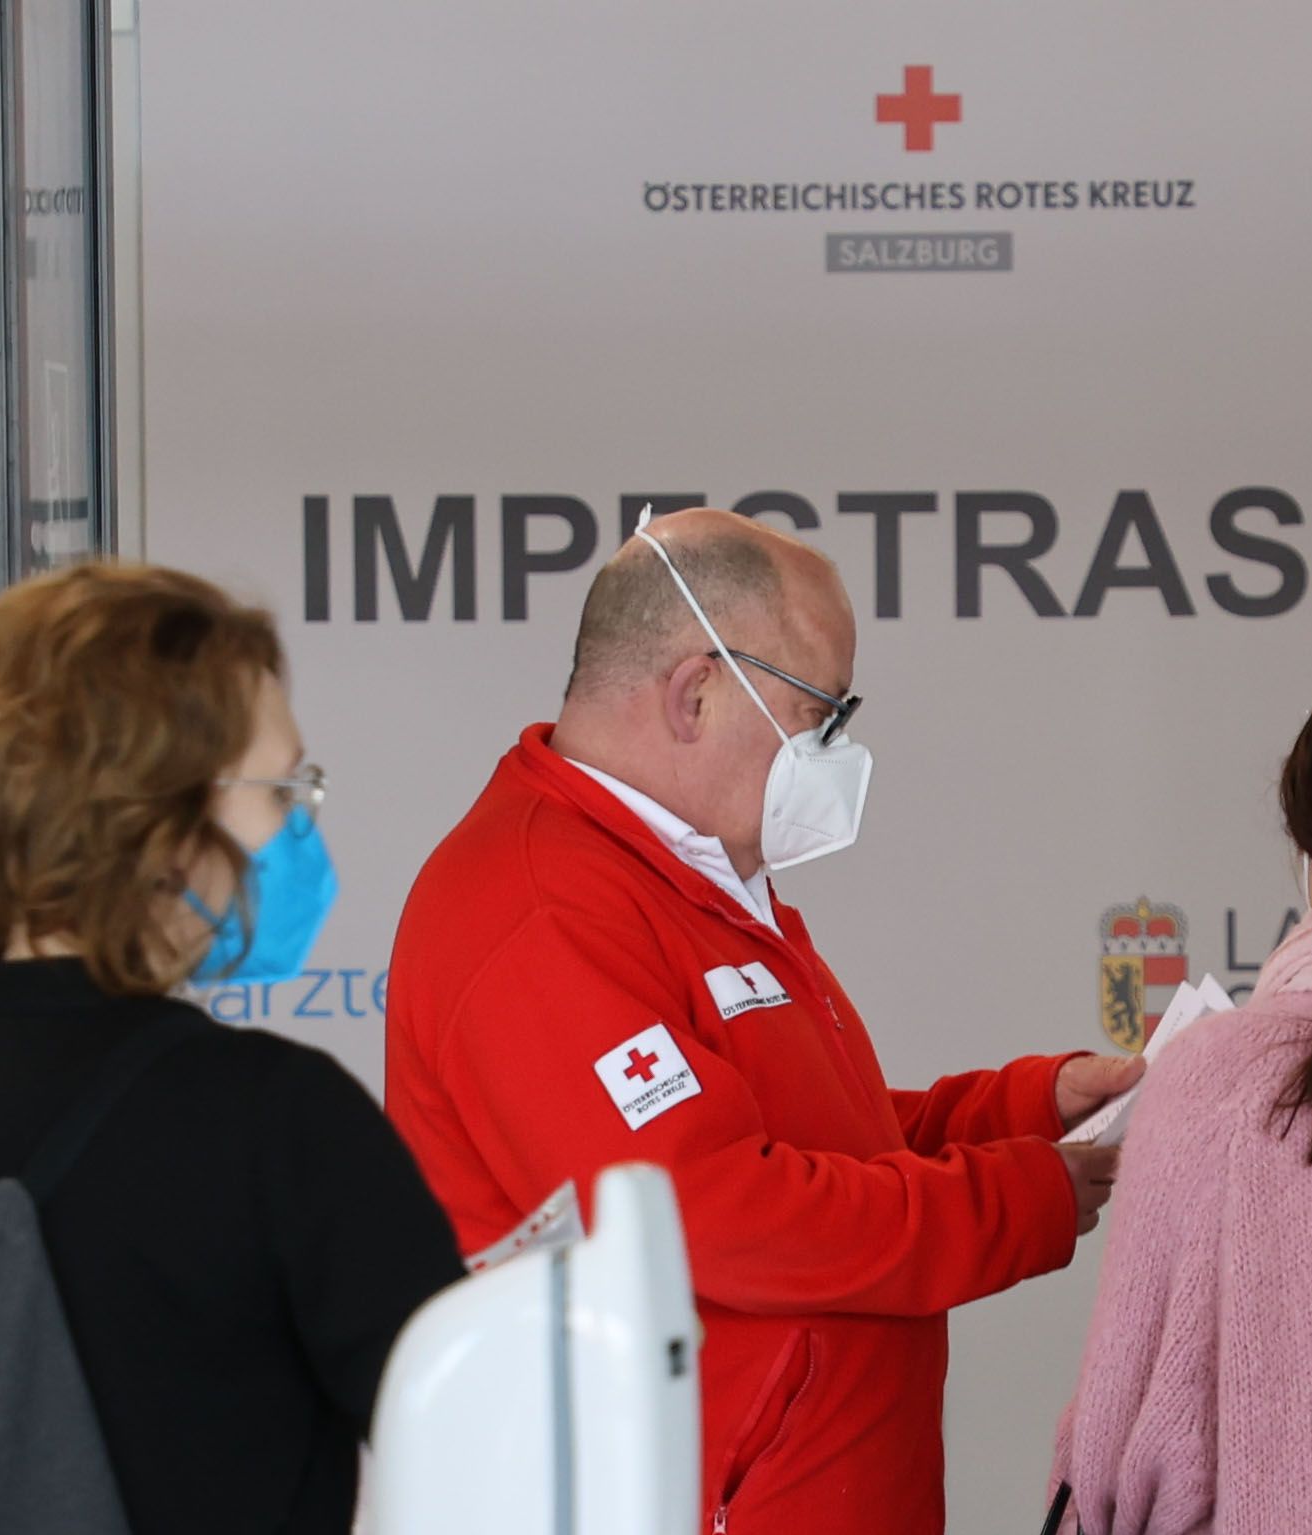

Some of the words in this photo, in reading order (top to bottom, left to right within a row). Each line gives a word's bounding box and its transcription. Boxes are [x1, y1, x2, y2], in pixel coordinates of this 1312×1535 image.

[643, 181, 966, 212] ÖSTERREICHISCHES
[975, 181, 1079, 211] ROTES
[1089, 179, 1196, 210] KREUZ
[838, 239, 999, 267] SALZBURG
